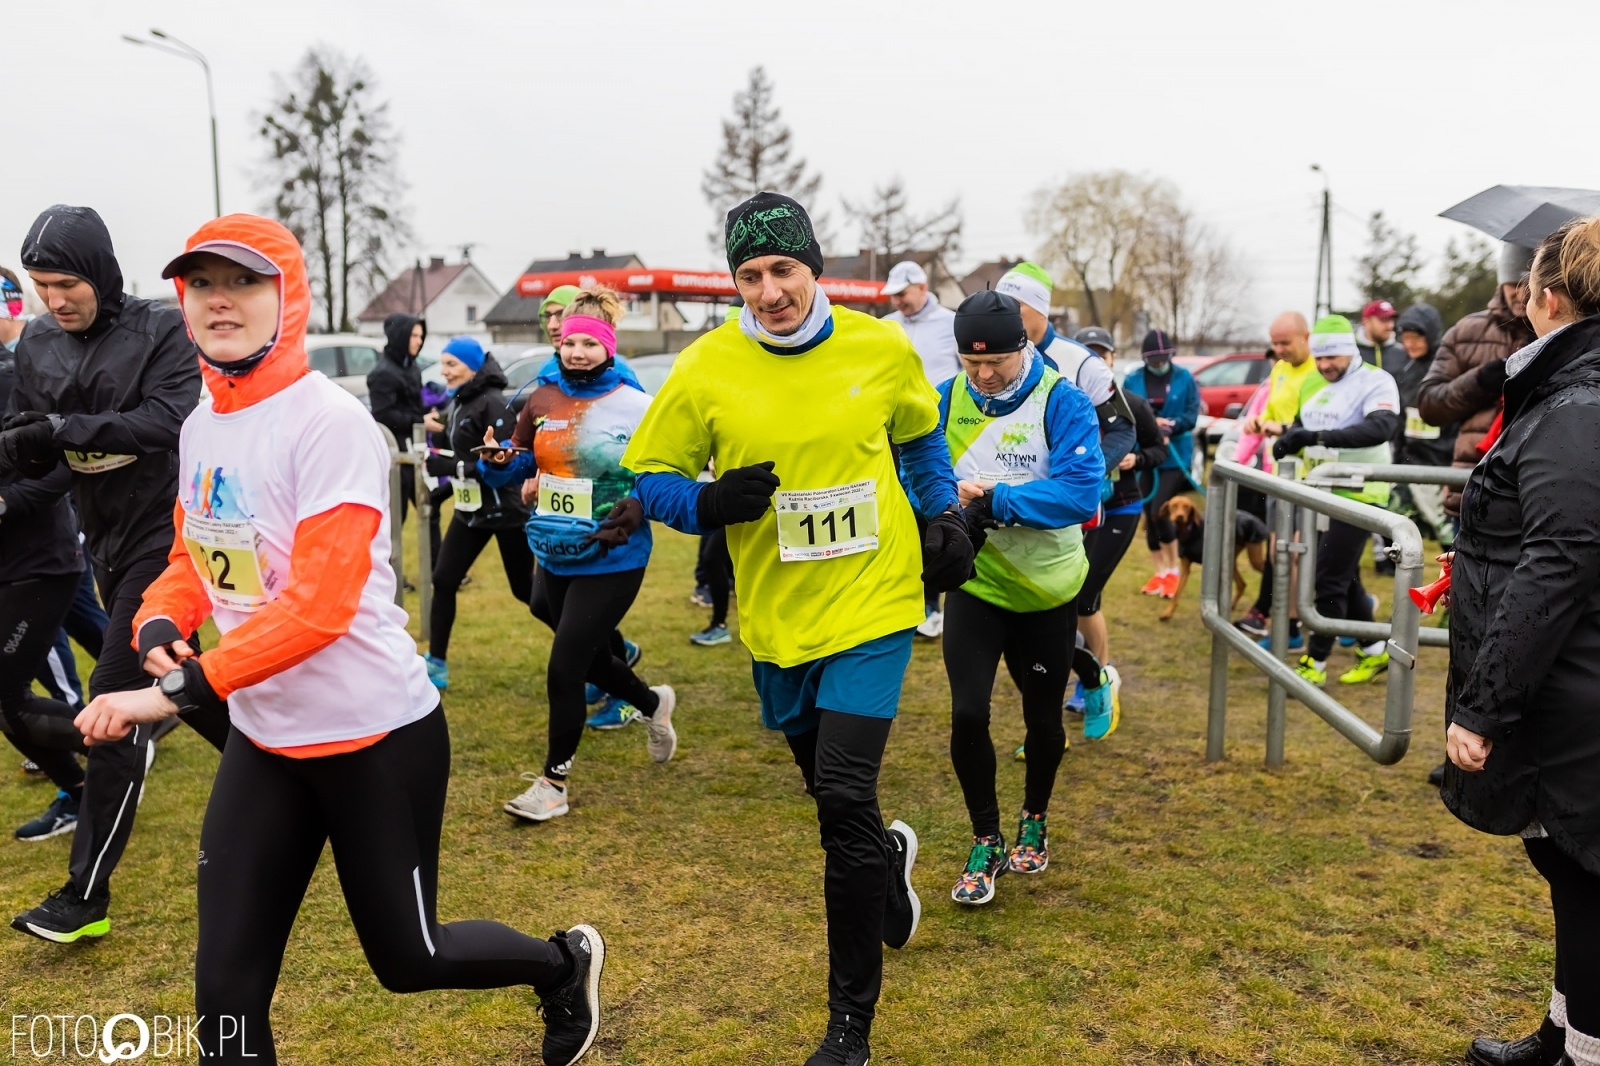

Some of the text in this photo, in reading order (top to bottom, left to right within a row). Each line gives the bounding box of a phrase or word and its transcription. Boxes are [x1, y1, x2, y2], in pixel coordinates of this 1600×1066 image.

[995, 452, 1037, 463] AKTYWNI
[550, 492, 575, 514] 66
[799, 506, 857, 545] 111
